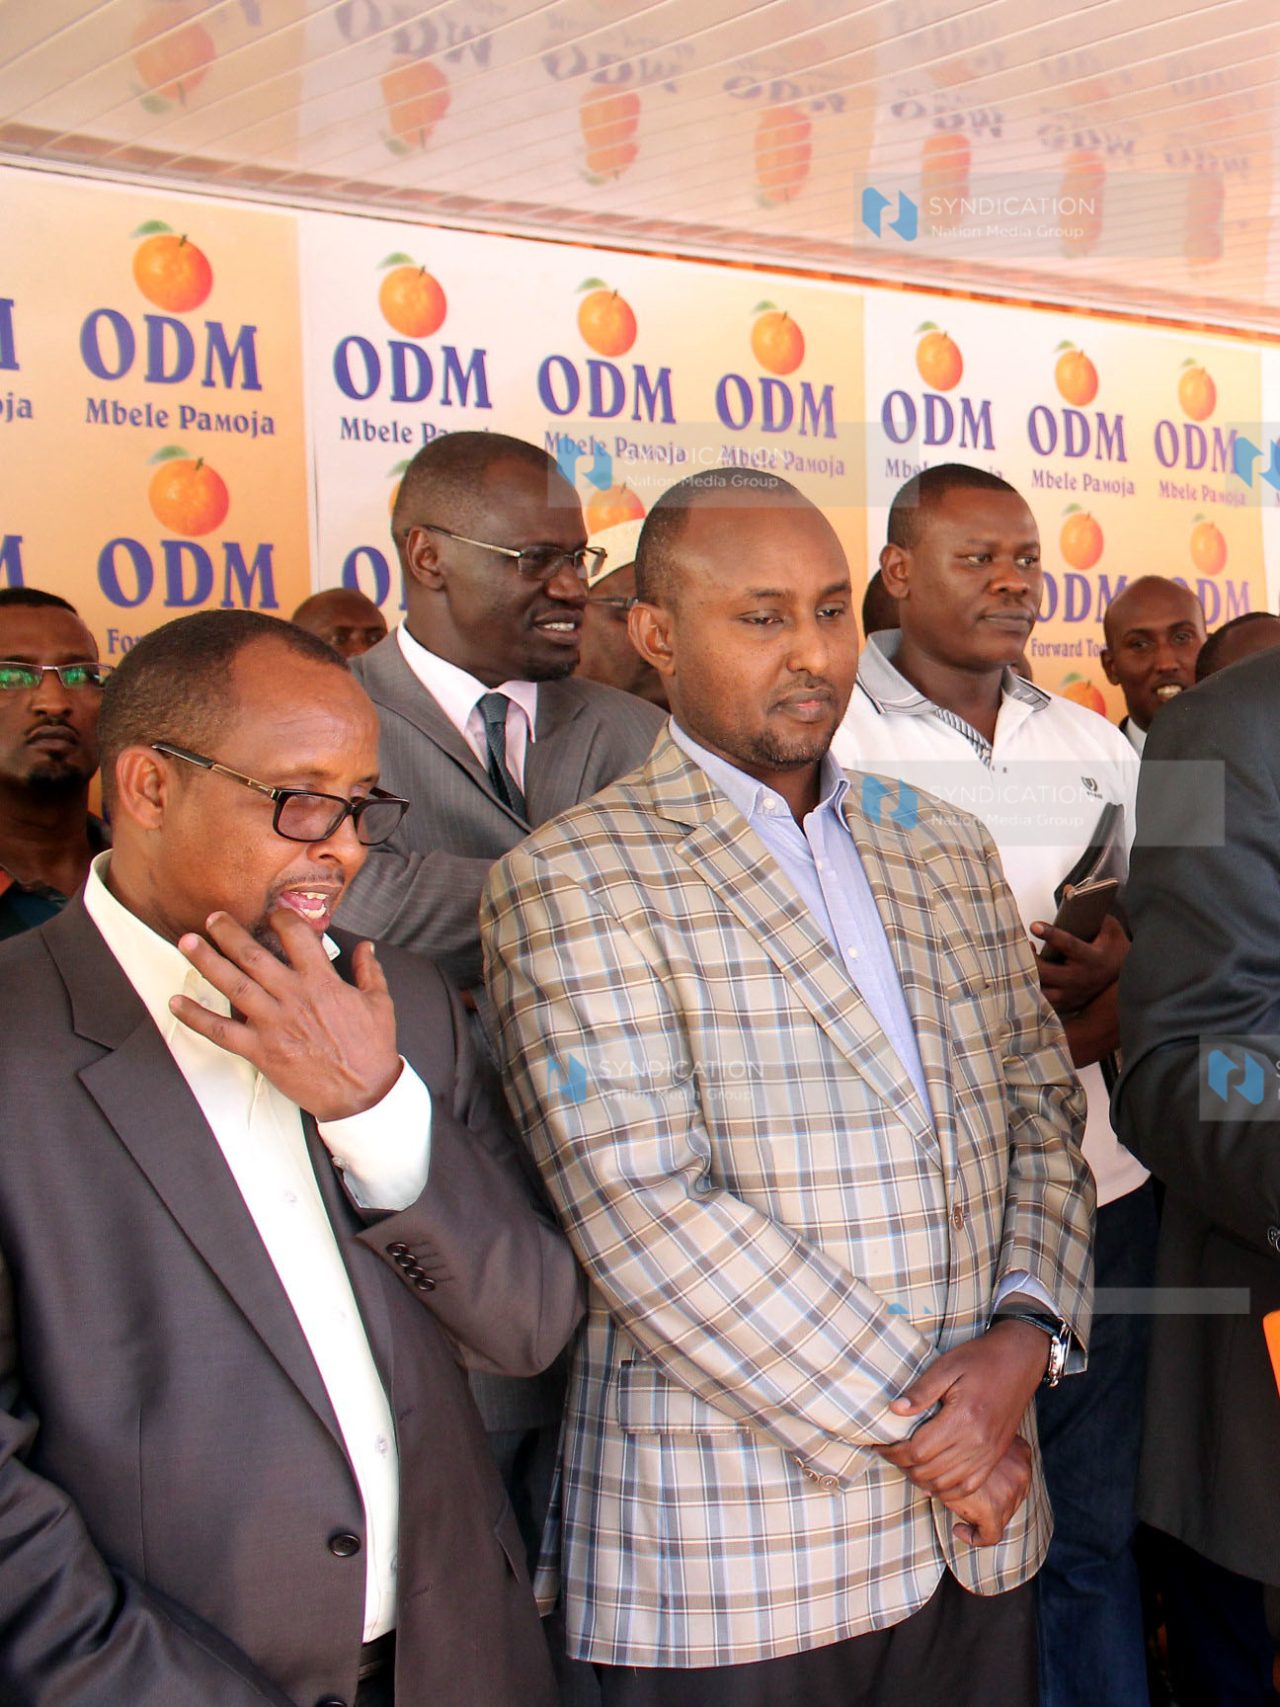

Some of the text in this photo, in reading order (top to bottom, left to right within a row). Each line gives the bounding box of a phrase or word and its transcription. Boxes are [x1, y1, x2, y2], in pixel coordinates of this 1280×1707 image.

[80, 308, 262, 391] ODM
[334, 335, 493, 409] ODM
[86, 398, 168, 428] Mbele
[538, 355, 676, 424] ODM
[716, 373, 837, 439] ODM
[340, 417, 412, 444] Mbele
[544, 431, 607, 457] Mbele
[881, 390, 996, 450] ODM
[1028, 405, 1127, 462] ODM
[1154, 420, 1239, 475] ODM
[1031, 469, 1076, 491] Mbele
[1159, 480, 1197, 502] Mbele
[98, 537, 279, 609] ODM
[1031, 638, 1082, 658] Forward
